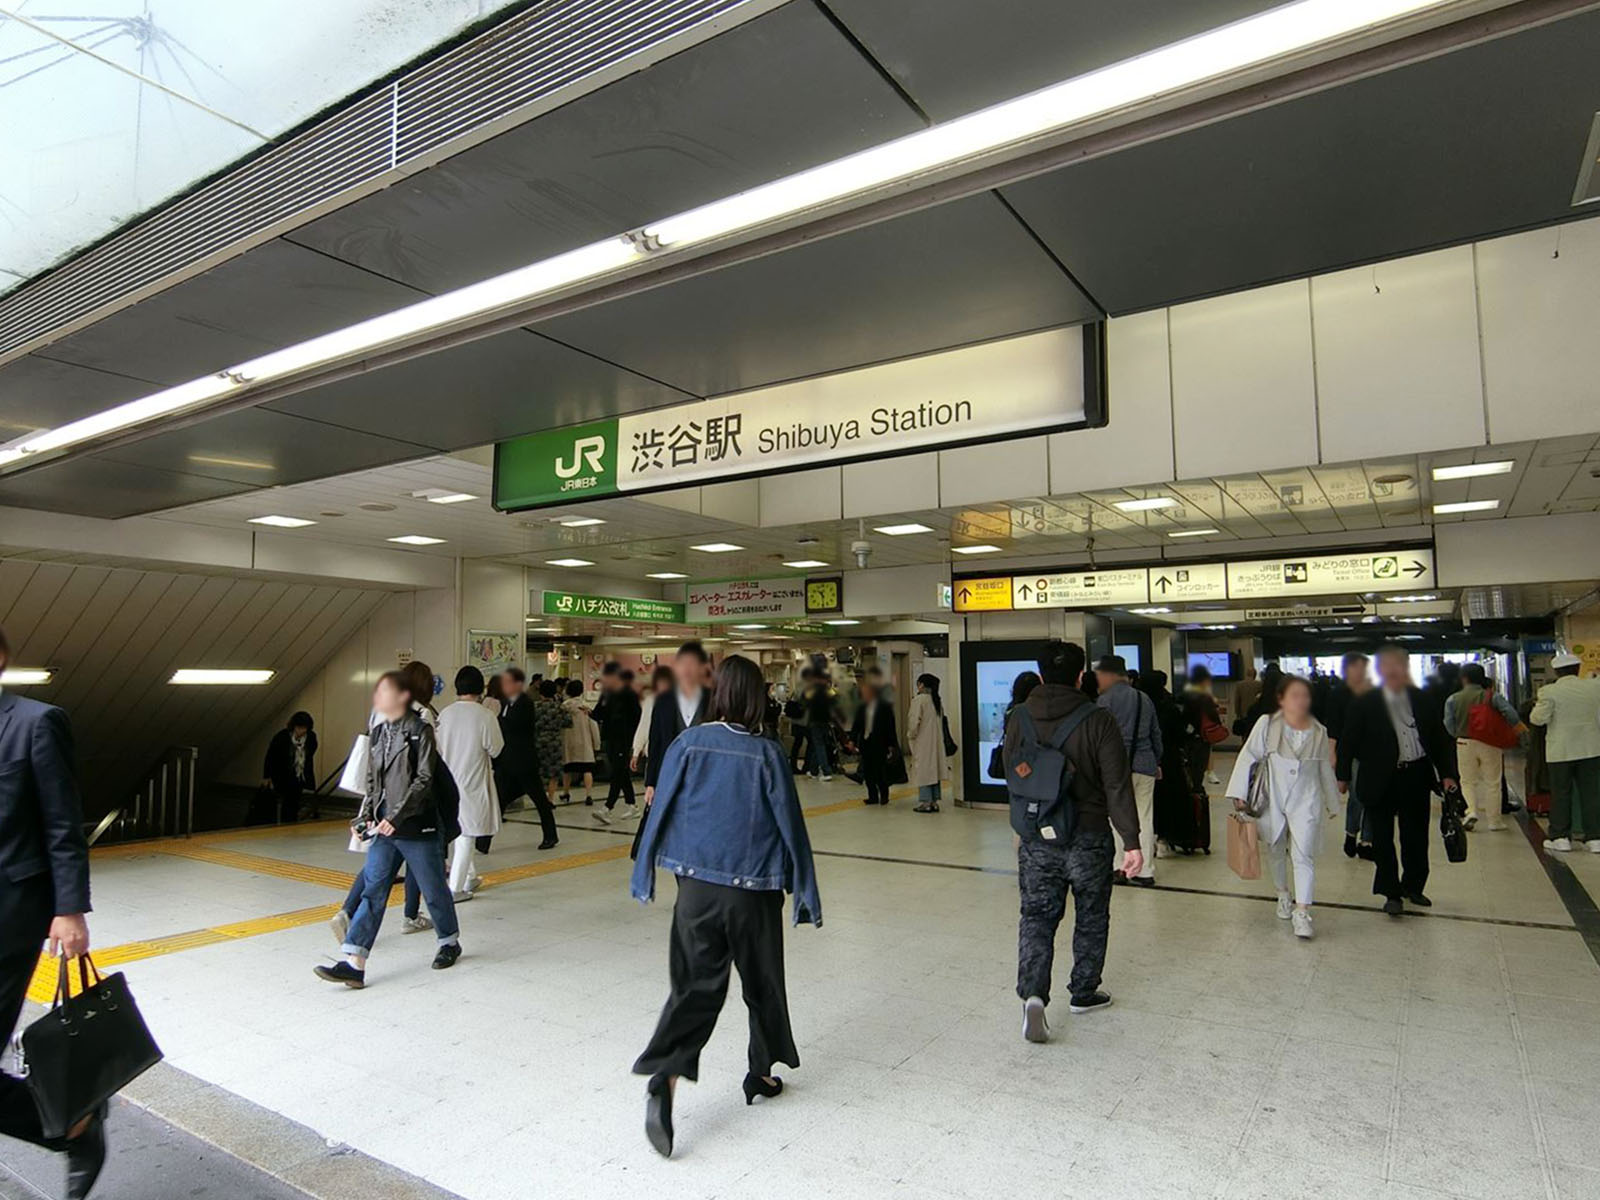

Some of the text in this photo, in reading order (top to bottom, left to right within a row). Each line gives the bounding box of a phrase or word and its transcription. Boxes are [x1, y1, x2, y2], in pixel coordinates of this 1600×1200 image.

[631, 399, 973, 473] 渋谷駅 Shibuya Station
[555, 435, 606, 479] JR
[560, 476, 598, 492] JR東日本
[1312, 558, 1370, 570] みどりの窓口
[1177, 583, 1220, 592] コインロッカー
[556, 596, 573, 608] JR
[575, 599, 630, 617] ハチ公改札
